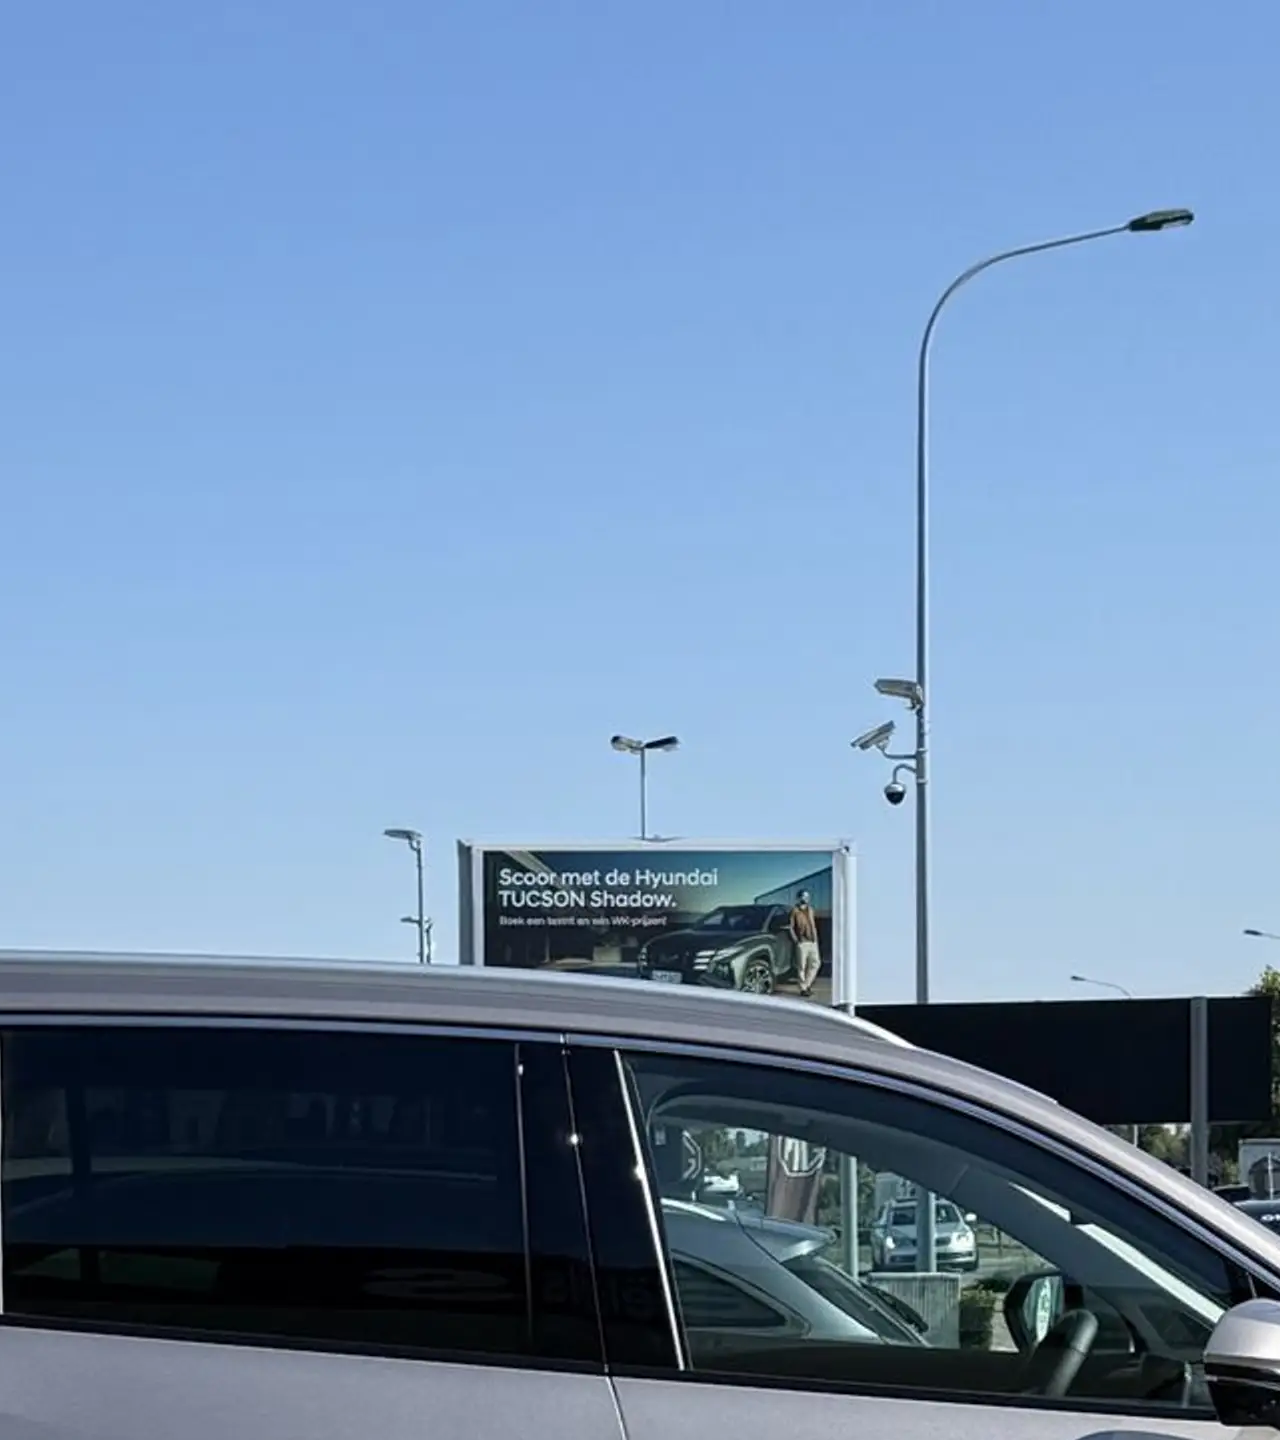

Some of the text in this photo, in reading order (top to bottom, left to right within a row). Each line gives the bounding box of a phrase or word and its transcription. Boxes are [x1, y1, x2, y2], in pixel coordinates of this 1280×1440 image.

[498, 867, 719, 889] Scoor met de Hyundai
[498, 890, 677, 908] TUCSON Shadow.
